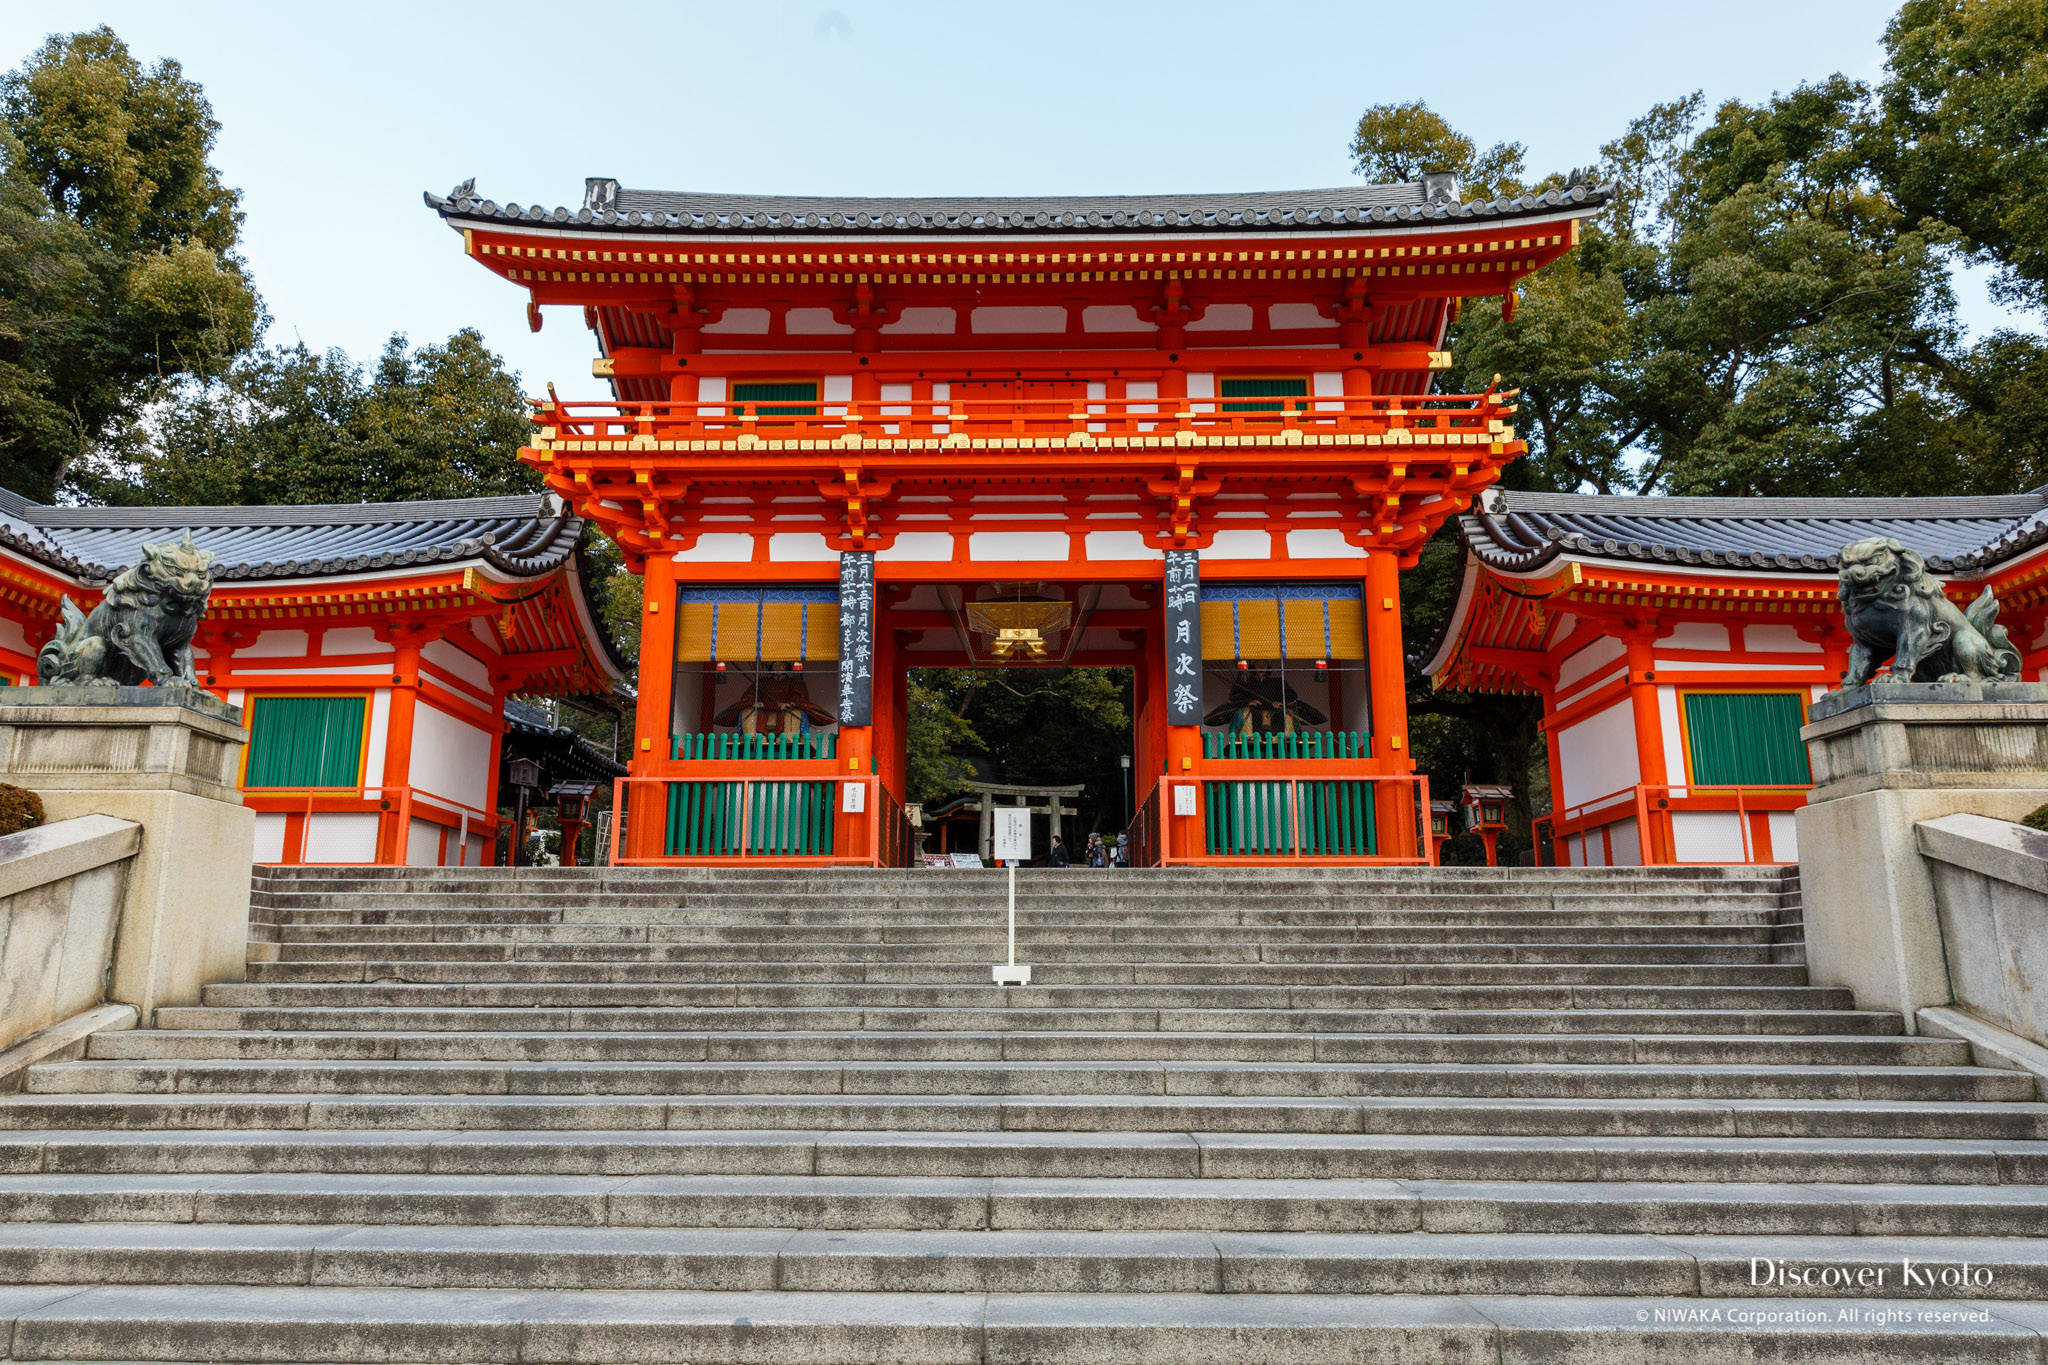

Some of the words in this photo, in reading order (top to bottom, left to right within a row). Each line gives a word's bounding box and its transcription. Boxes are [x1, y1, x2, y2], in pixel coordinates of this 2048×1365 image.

[1166, 551, 1184, 611] 午前十時
[1180, 552, 1198, 603] 三月一日
[1173, 619, 1199, 715] 月次祭
